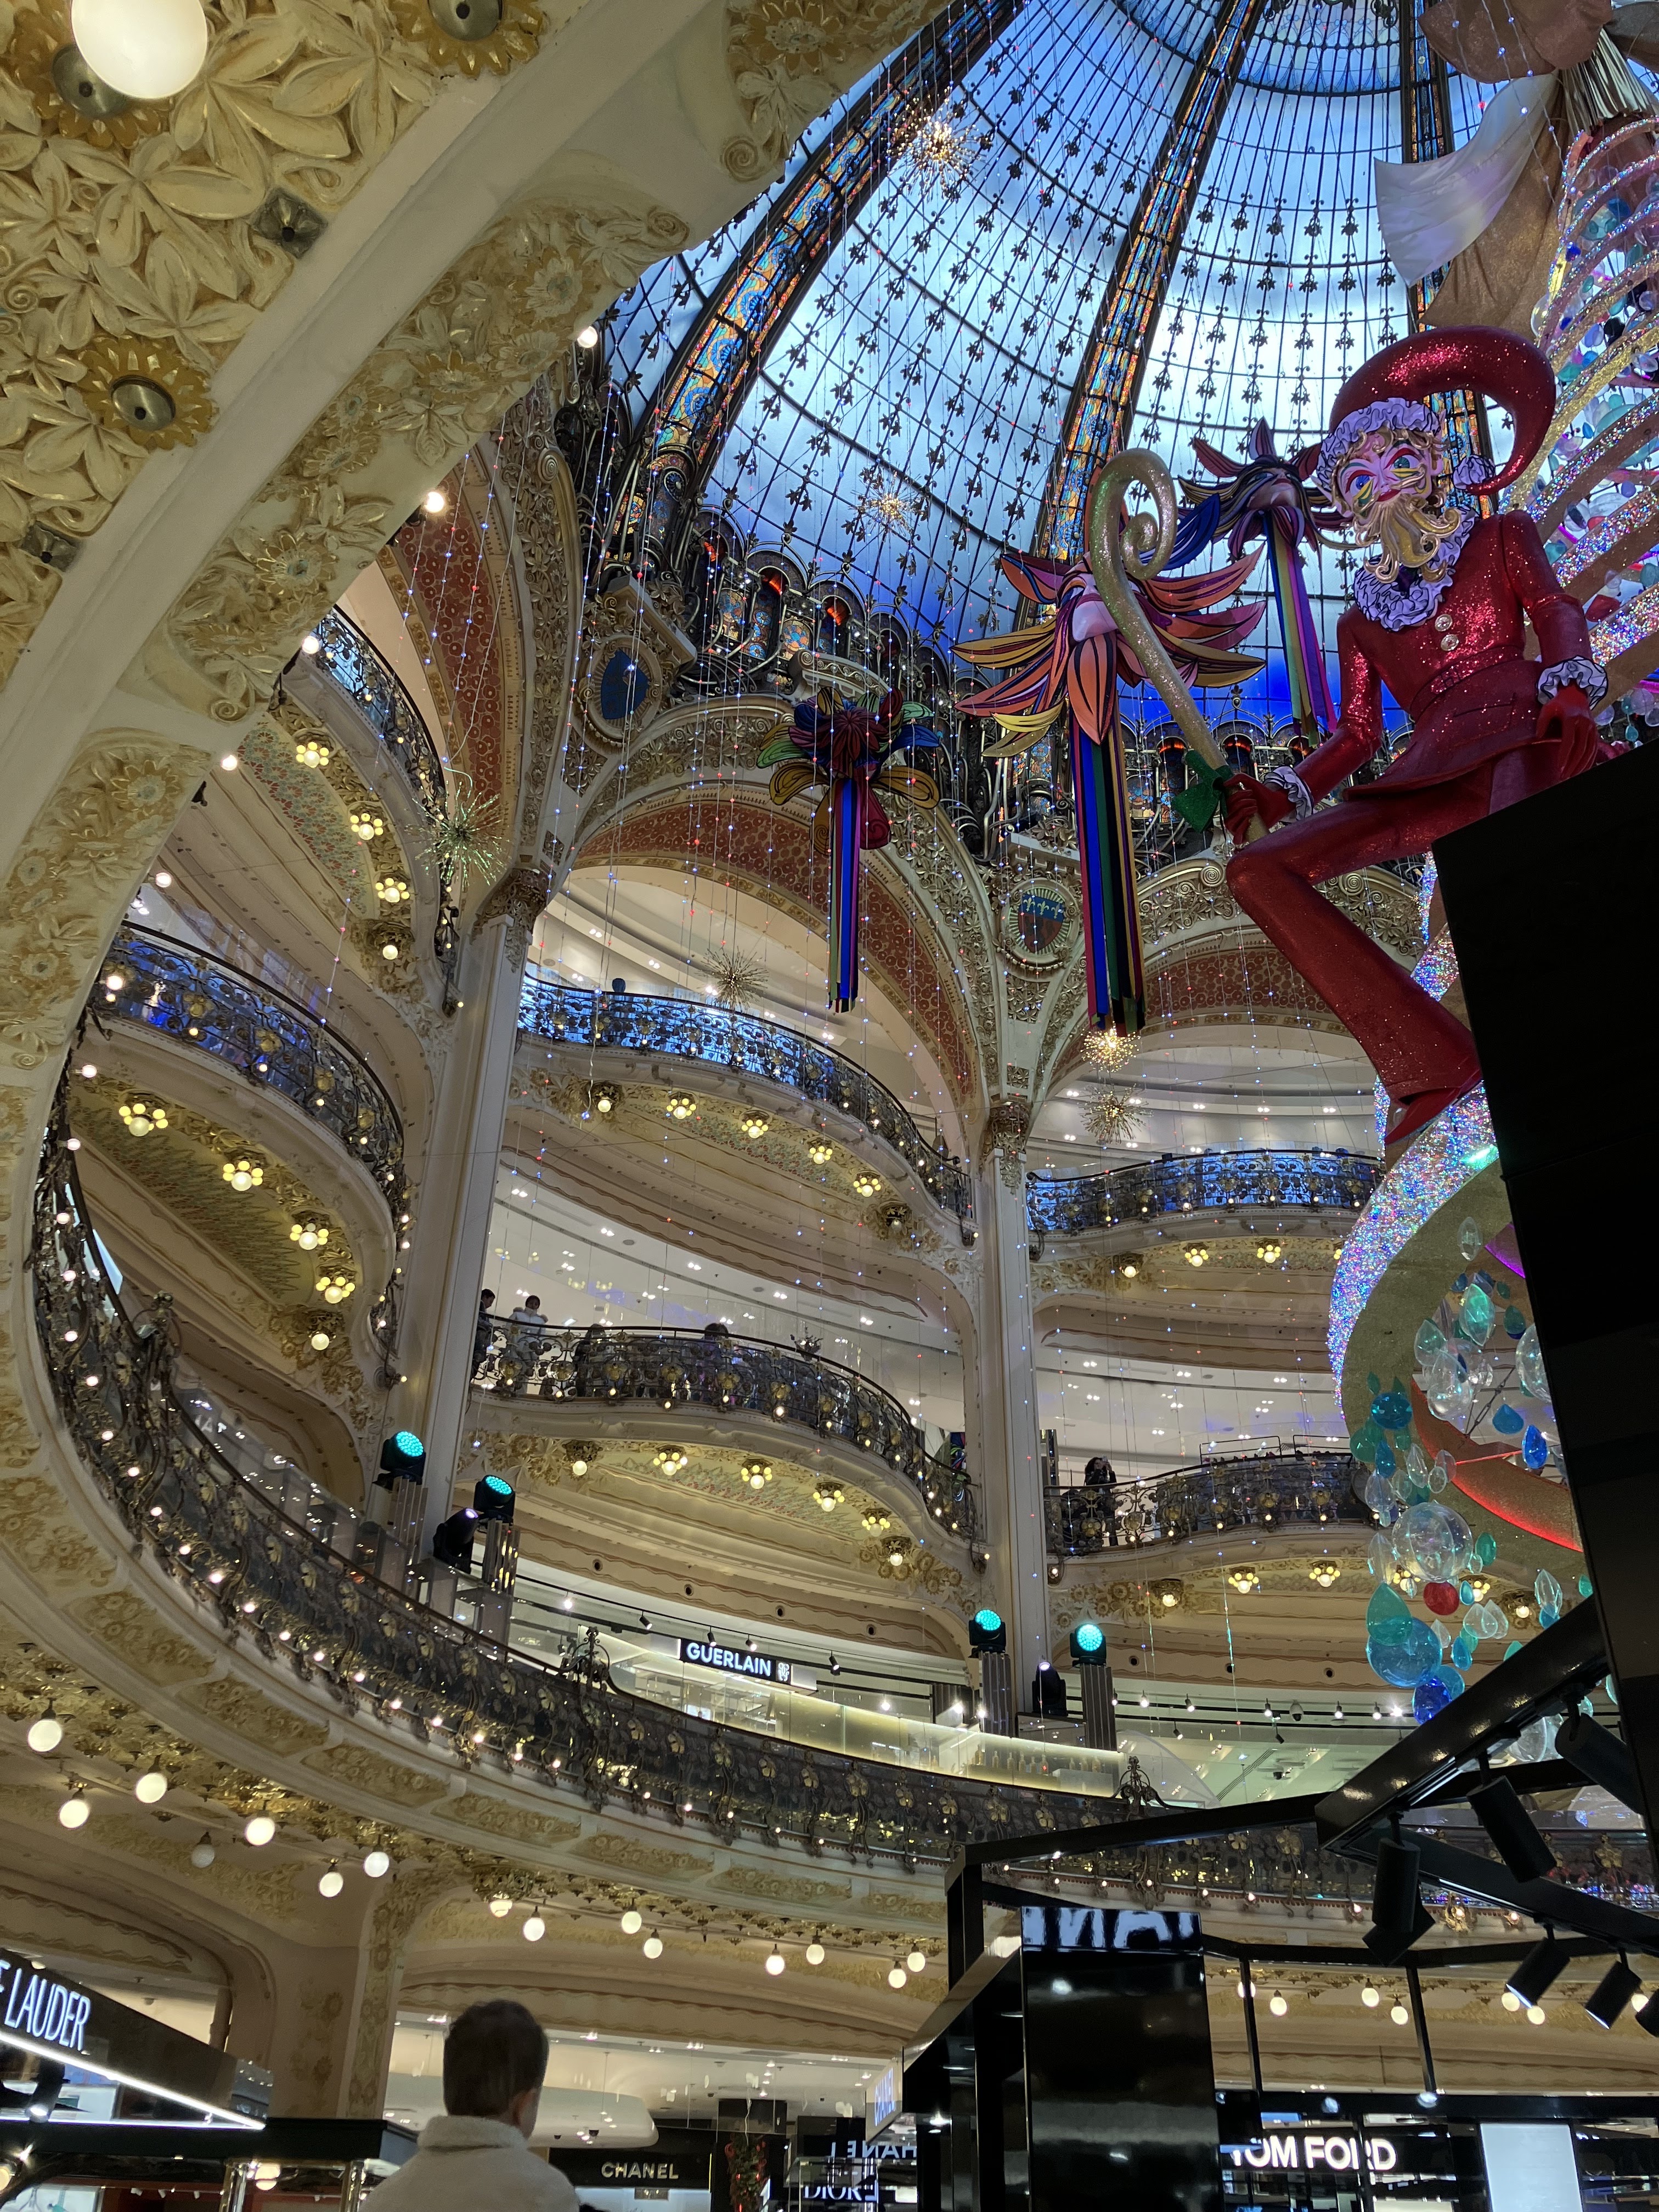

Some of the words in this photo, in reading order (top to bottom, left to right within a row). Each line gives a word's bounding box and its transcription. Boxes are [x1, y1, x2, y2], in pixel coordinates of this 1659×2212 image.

[687, 1642, 771, 1677] GUERLAIN
[4, 1968, 91, 2051] LAUDER
[1304, 2136, 1397, 2170] FORD
[601, 2162, 679, 2180] CHANEL
